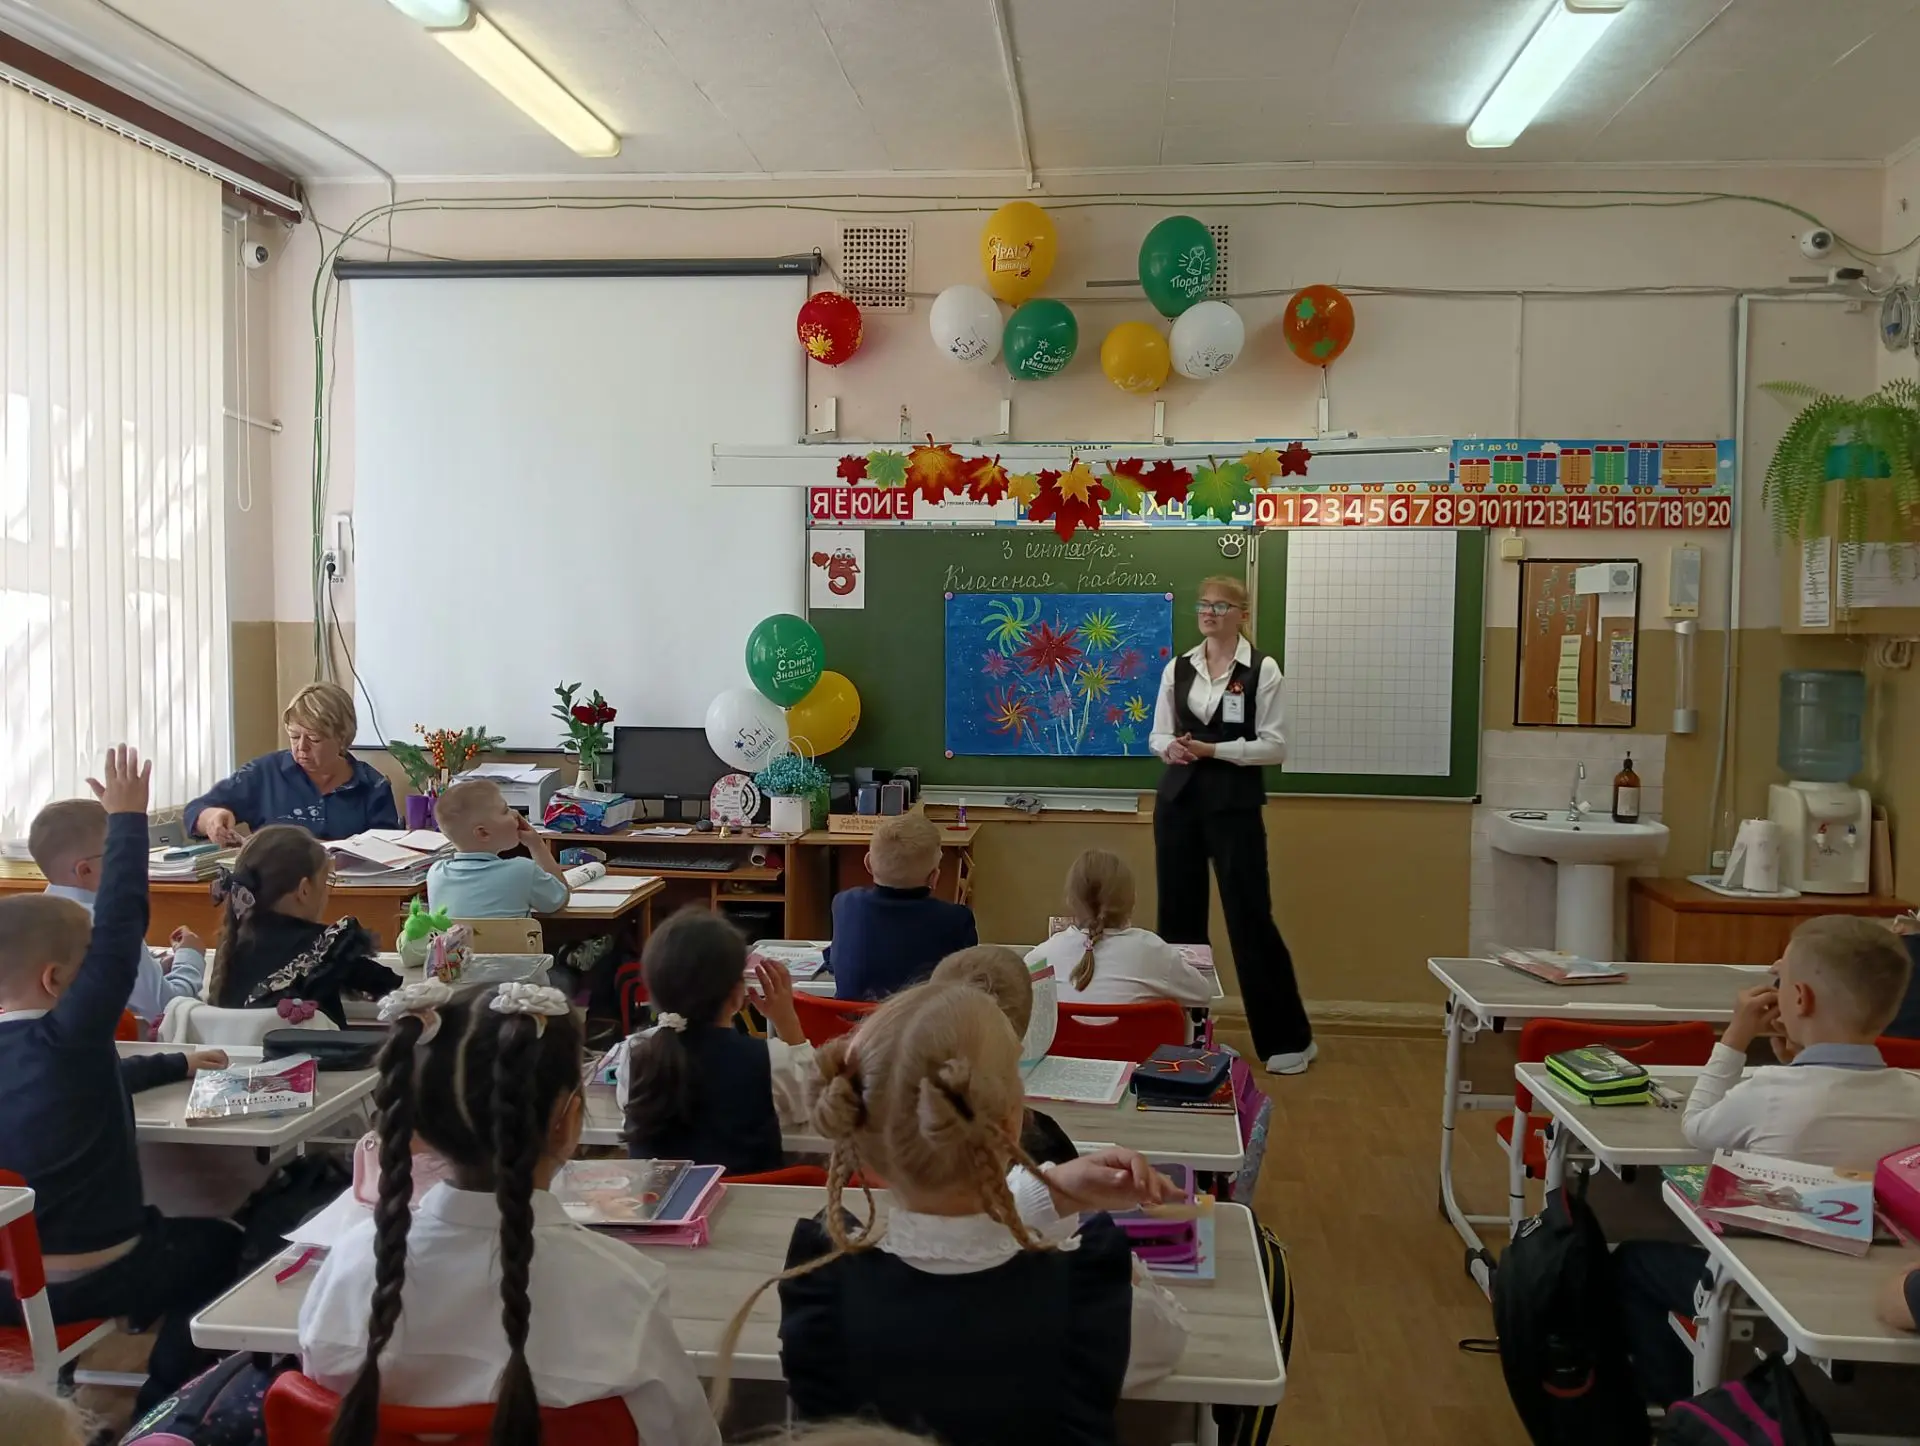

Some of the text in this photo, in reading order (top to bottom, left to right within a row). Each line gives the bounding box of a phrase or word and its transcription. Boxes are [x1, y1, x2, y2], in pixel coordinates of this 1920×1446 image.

[1170, 275, 1198, 291] Пора
[1488, 444, 1502, 452] до
[1505, 442, 1518, 451] 10
[1258, 499, 1731, 525] 0 1 2 3 4 5 6 7 8 9 10 11 12 13 14 15 16 17 18 19 20
[1002, 539, 1013, 560] 3
[943, 564, 1055, 591] Классная
[775, 661, 815, 680] Знаний!
[777, 660, 786, 671] С
[739, 727, 761, 747] 5+
[1816, 1199, 1864, 1226] 2
